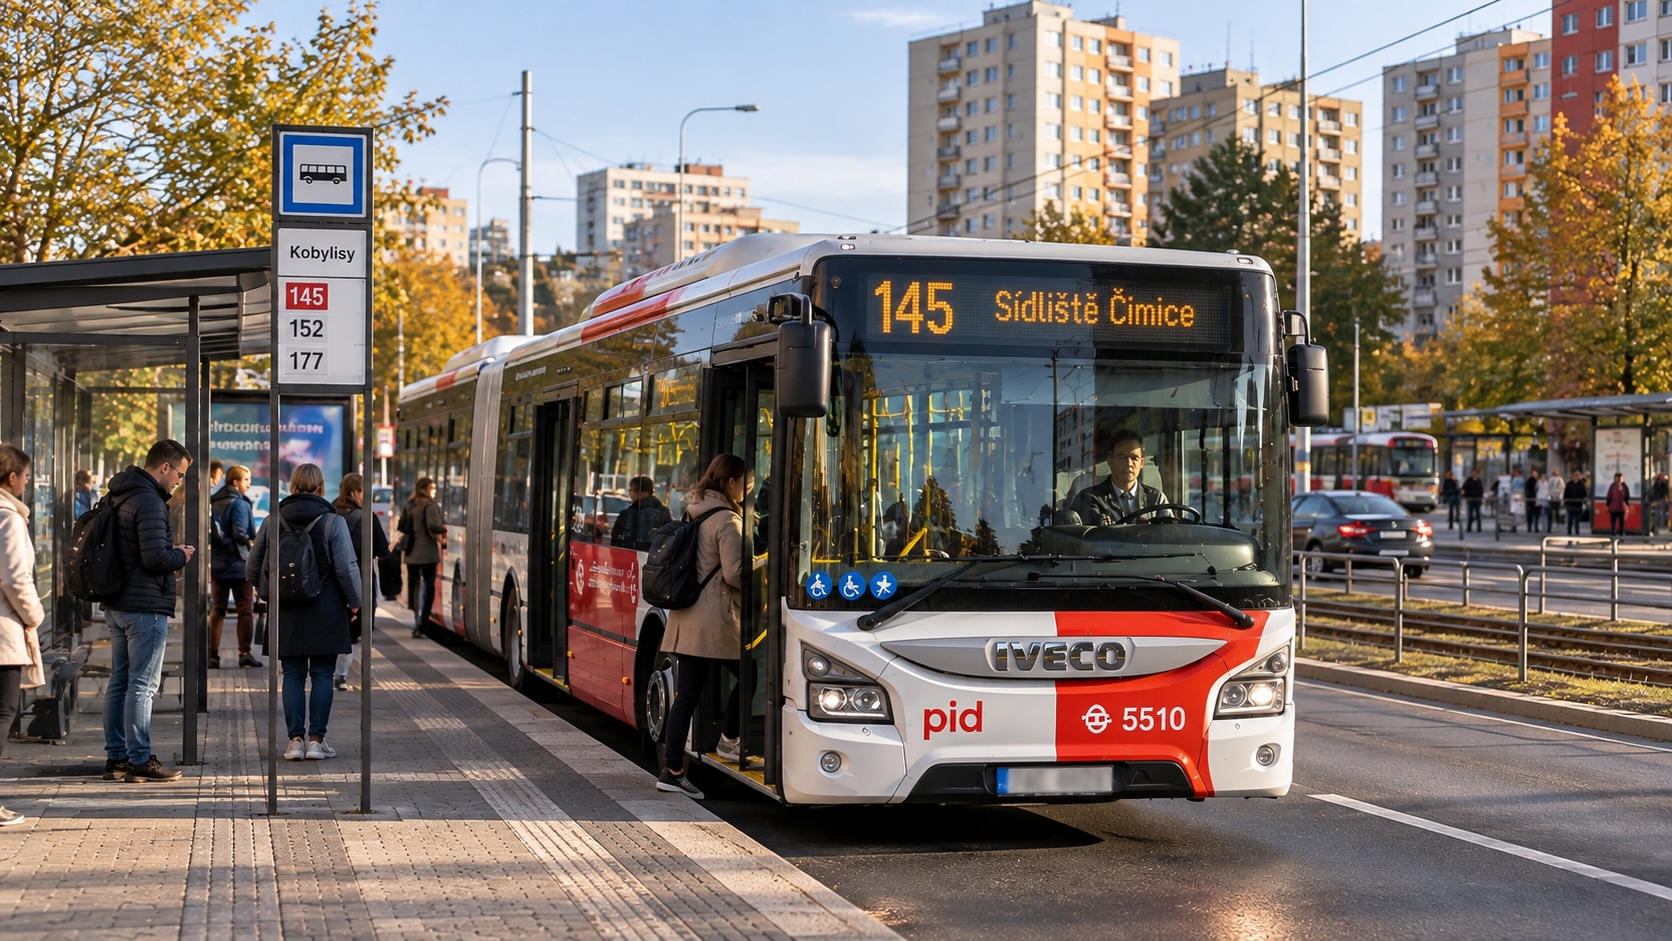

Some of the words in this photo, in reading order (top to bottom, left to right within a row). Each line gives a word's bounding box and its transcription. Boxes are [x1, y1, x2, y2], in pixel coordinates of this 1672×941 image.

[290, 245, 355, 263] Kobylisy
[290, 287, 324, 306] 145
[874, 280, 954, 334] 145
[995, 290, 1098, 324] Sídliště
[1109, 288, 1195, 328] Čimice
[289, 318, 323, 337] 152
[289, 351, 323, 370] 177
[994, 641, 1127, 672] IVECO
[923, 700, 983, 740] pid
[1122, 707, 1187, 732] 5510
